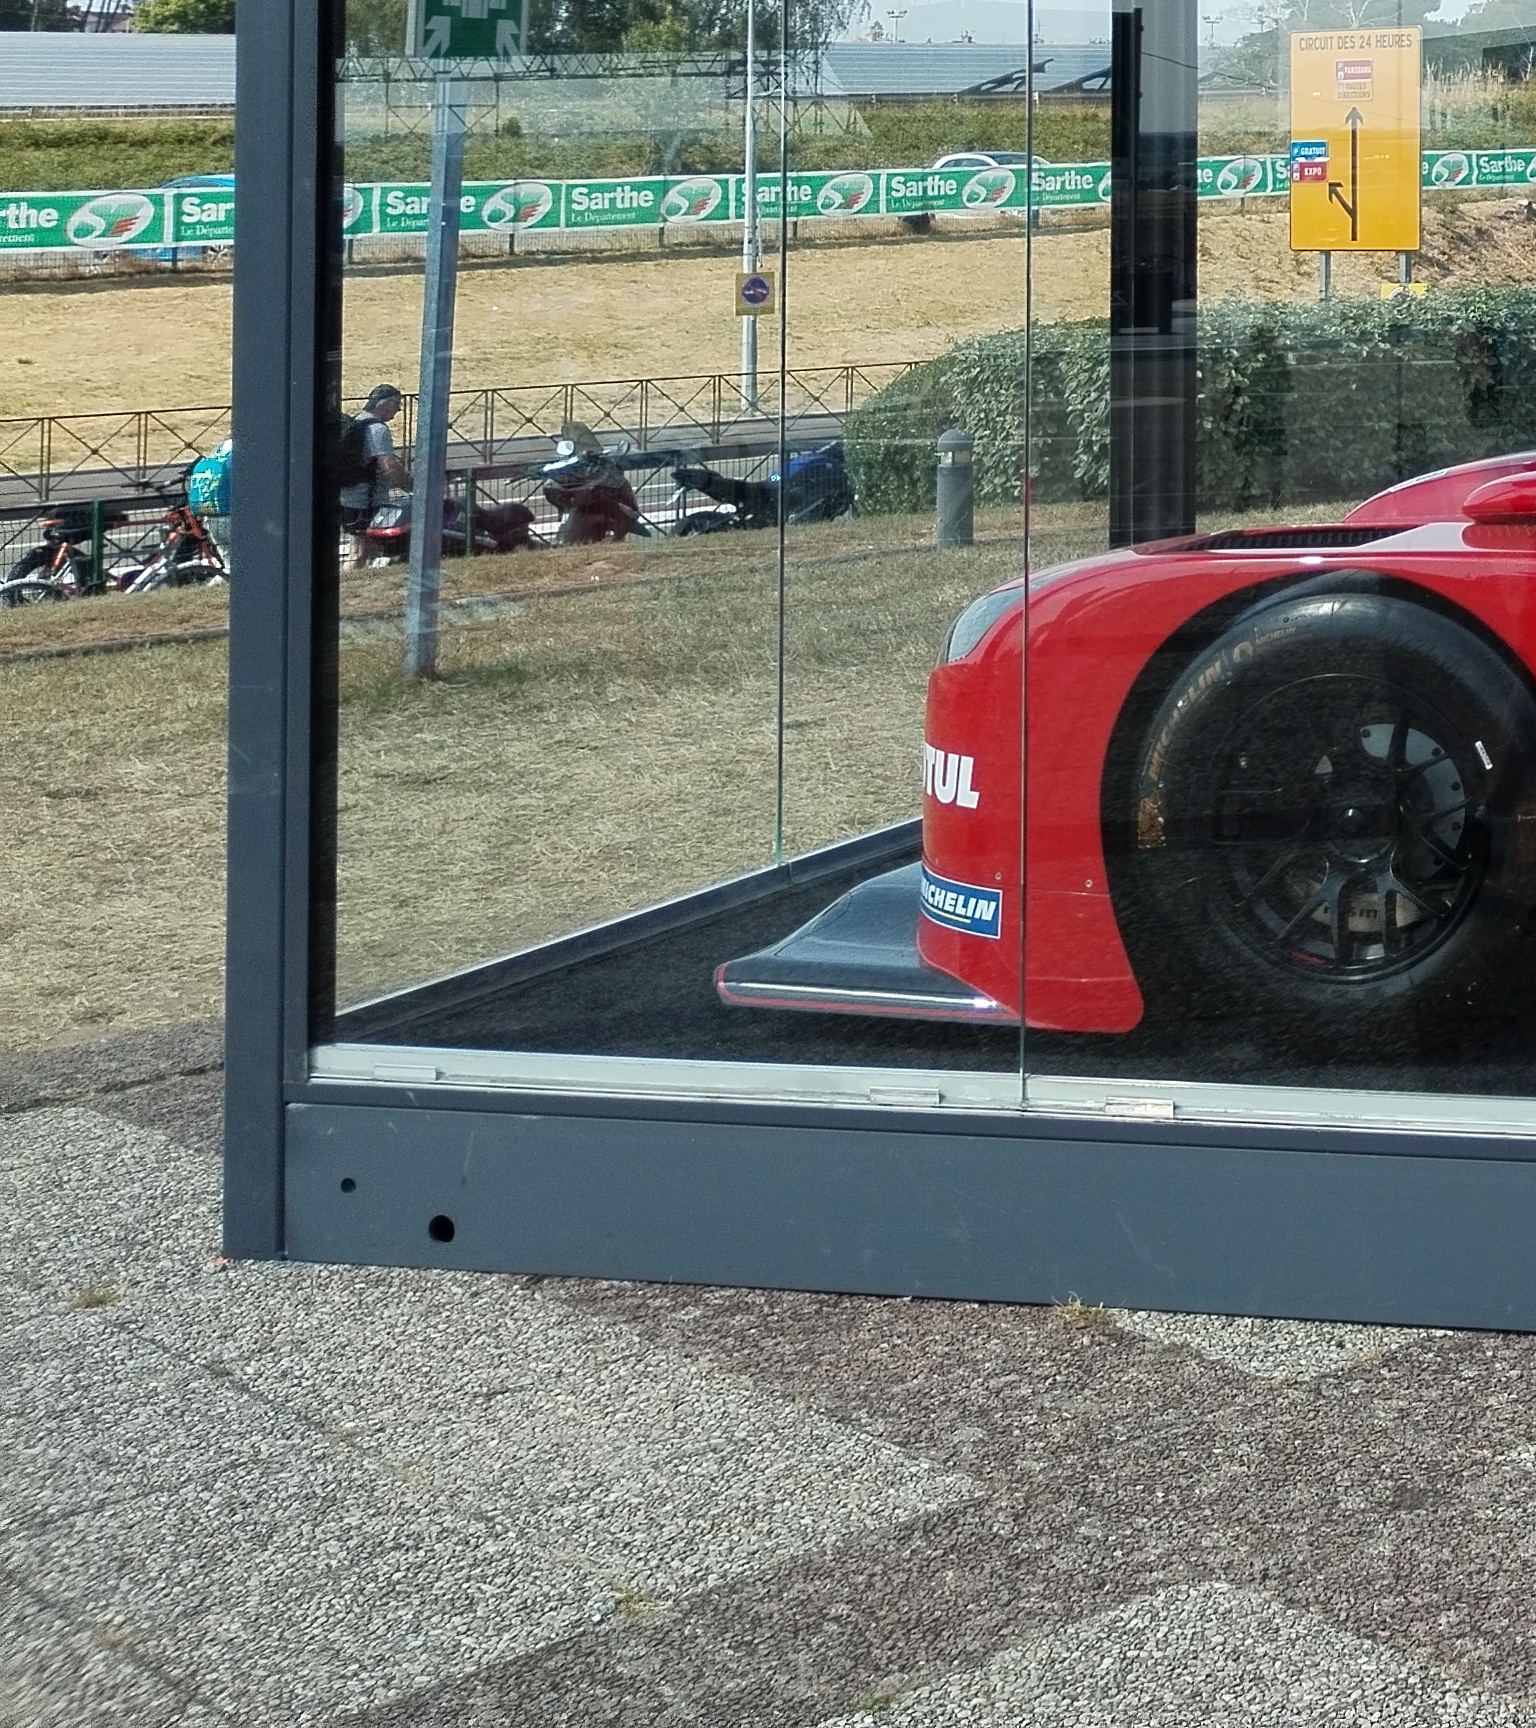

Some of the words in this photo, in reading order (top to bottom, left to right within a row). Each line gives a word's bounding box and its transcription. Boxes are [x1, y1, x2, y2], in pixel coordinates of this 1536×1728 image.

[1300, 36, 1334, 51] CIRCUIT
[1337, 35, 1356, 49] DES
[1359, 35, 1371, 49] 24
[1375, 33, 1412, 48] HEURES
[1304, 167, 1322, 175] EXPO
[1481, 157, 1526, 173] Sarthe
[891, 174, 957, 198] Sarthe
[1030, 167, 1094, 191] Sarthe
[181, 197, 234, 223] Sar
[386, 189, 475, 215] Sare
[572, 185, 654, 211] Sarthe
[198, 226, 234, 238] Départe
[924, 742, 980, 809] TUL
